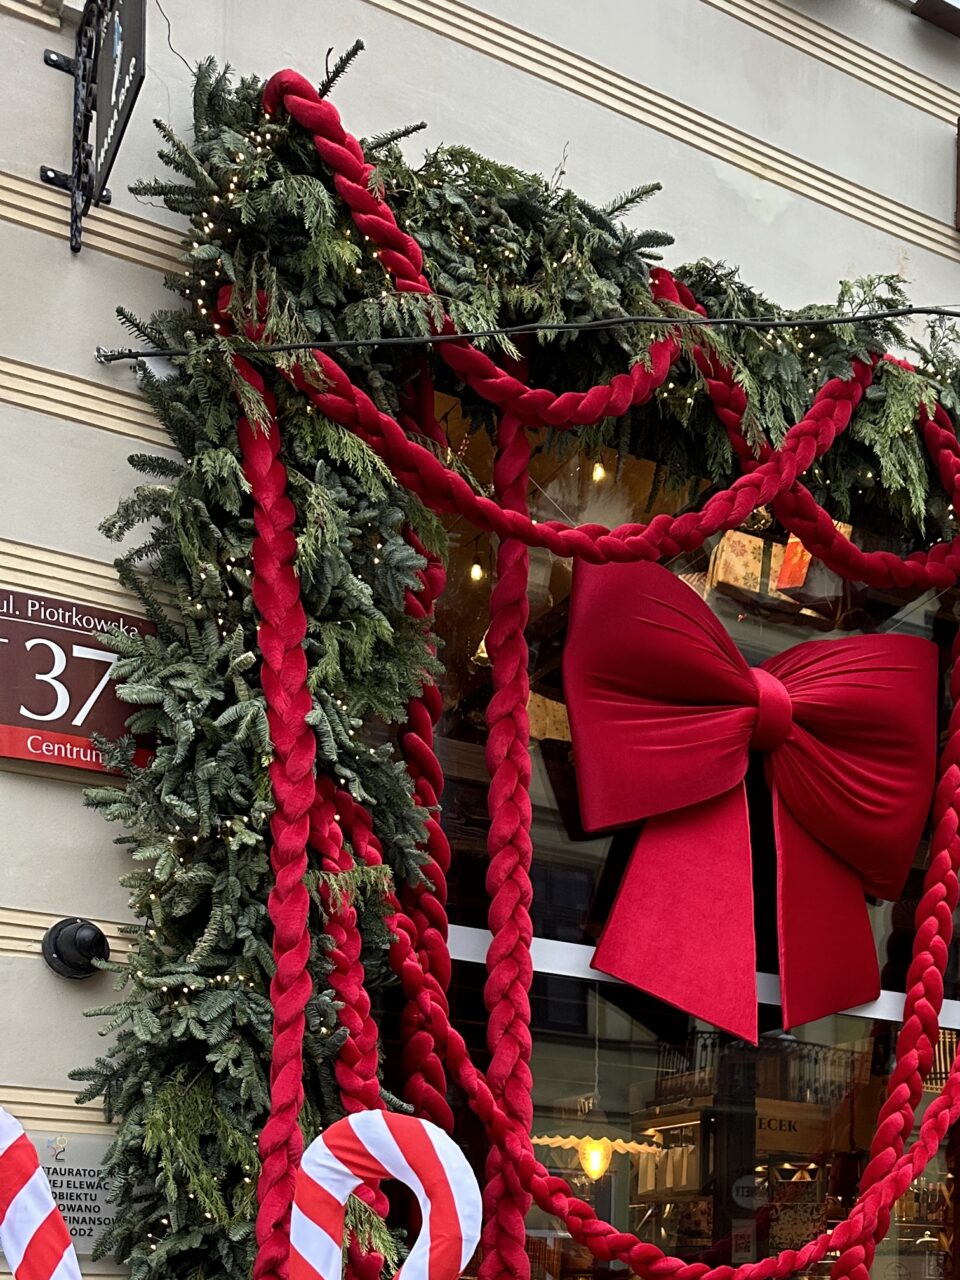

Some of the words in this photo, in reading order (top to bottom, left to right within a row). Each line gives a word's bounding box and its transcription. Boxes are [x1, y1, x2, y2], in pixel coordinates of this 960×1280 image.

[0, 595, 20, 615] ul.
[28, 599, 139, 639] Piotrkowska
[0, 637, 119, 727] 37
[758, 1117, 798, 1132] ECEK
[66, 1180, 110, 1191] ELEWAC
[57, 1203, 101, 1214] OWANO
[69, 1225, 94, 1237] ÓDŹ
